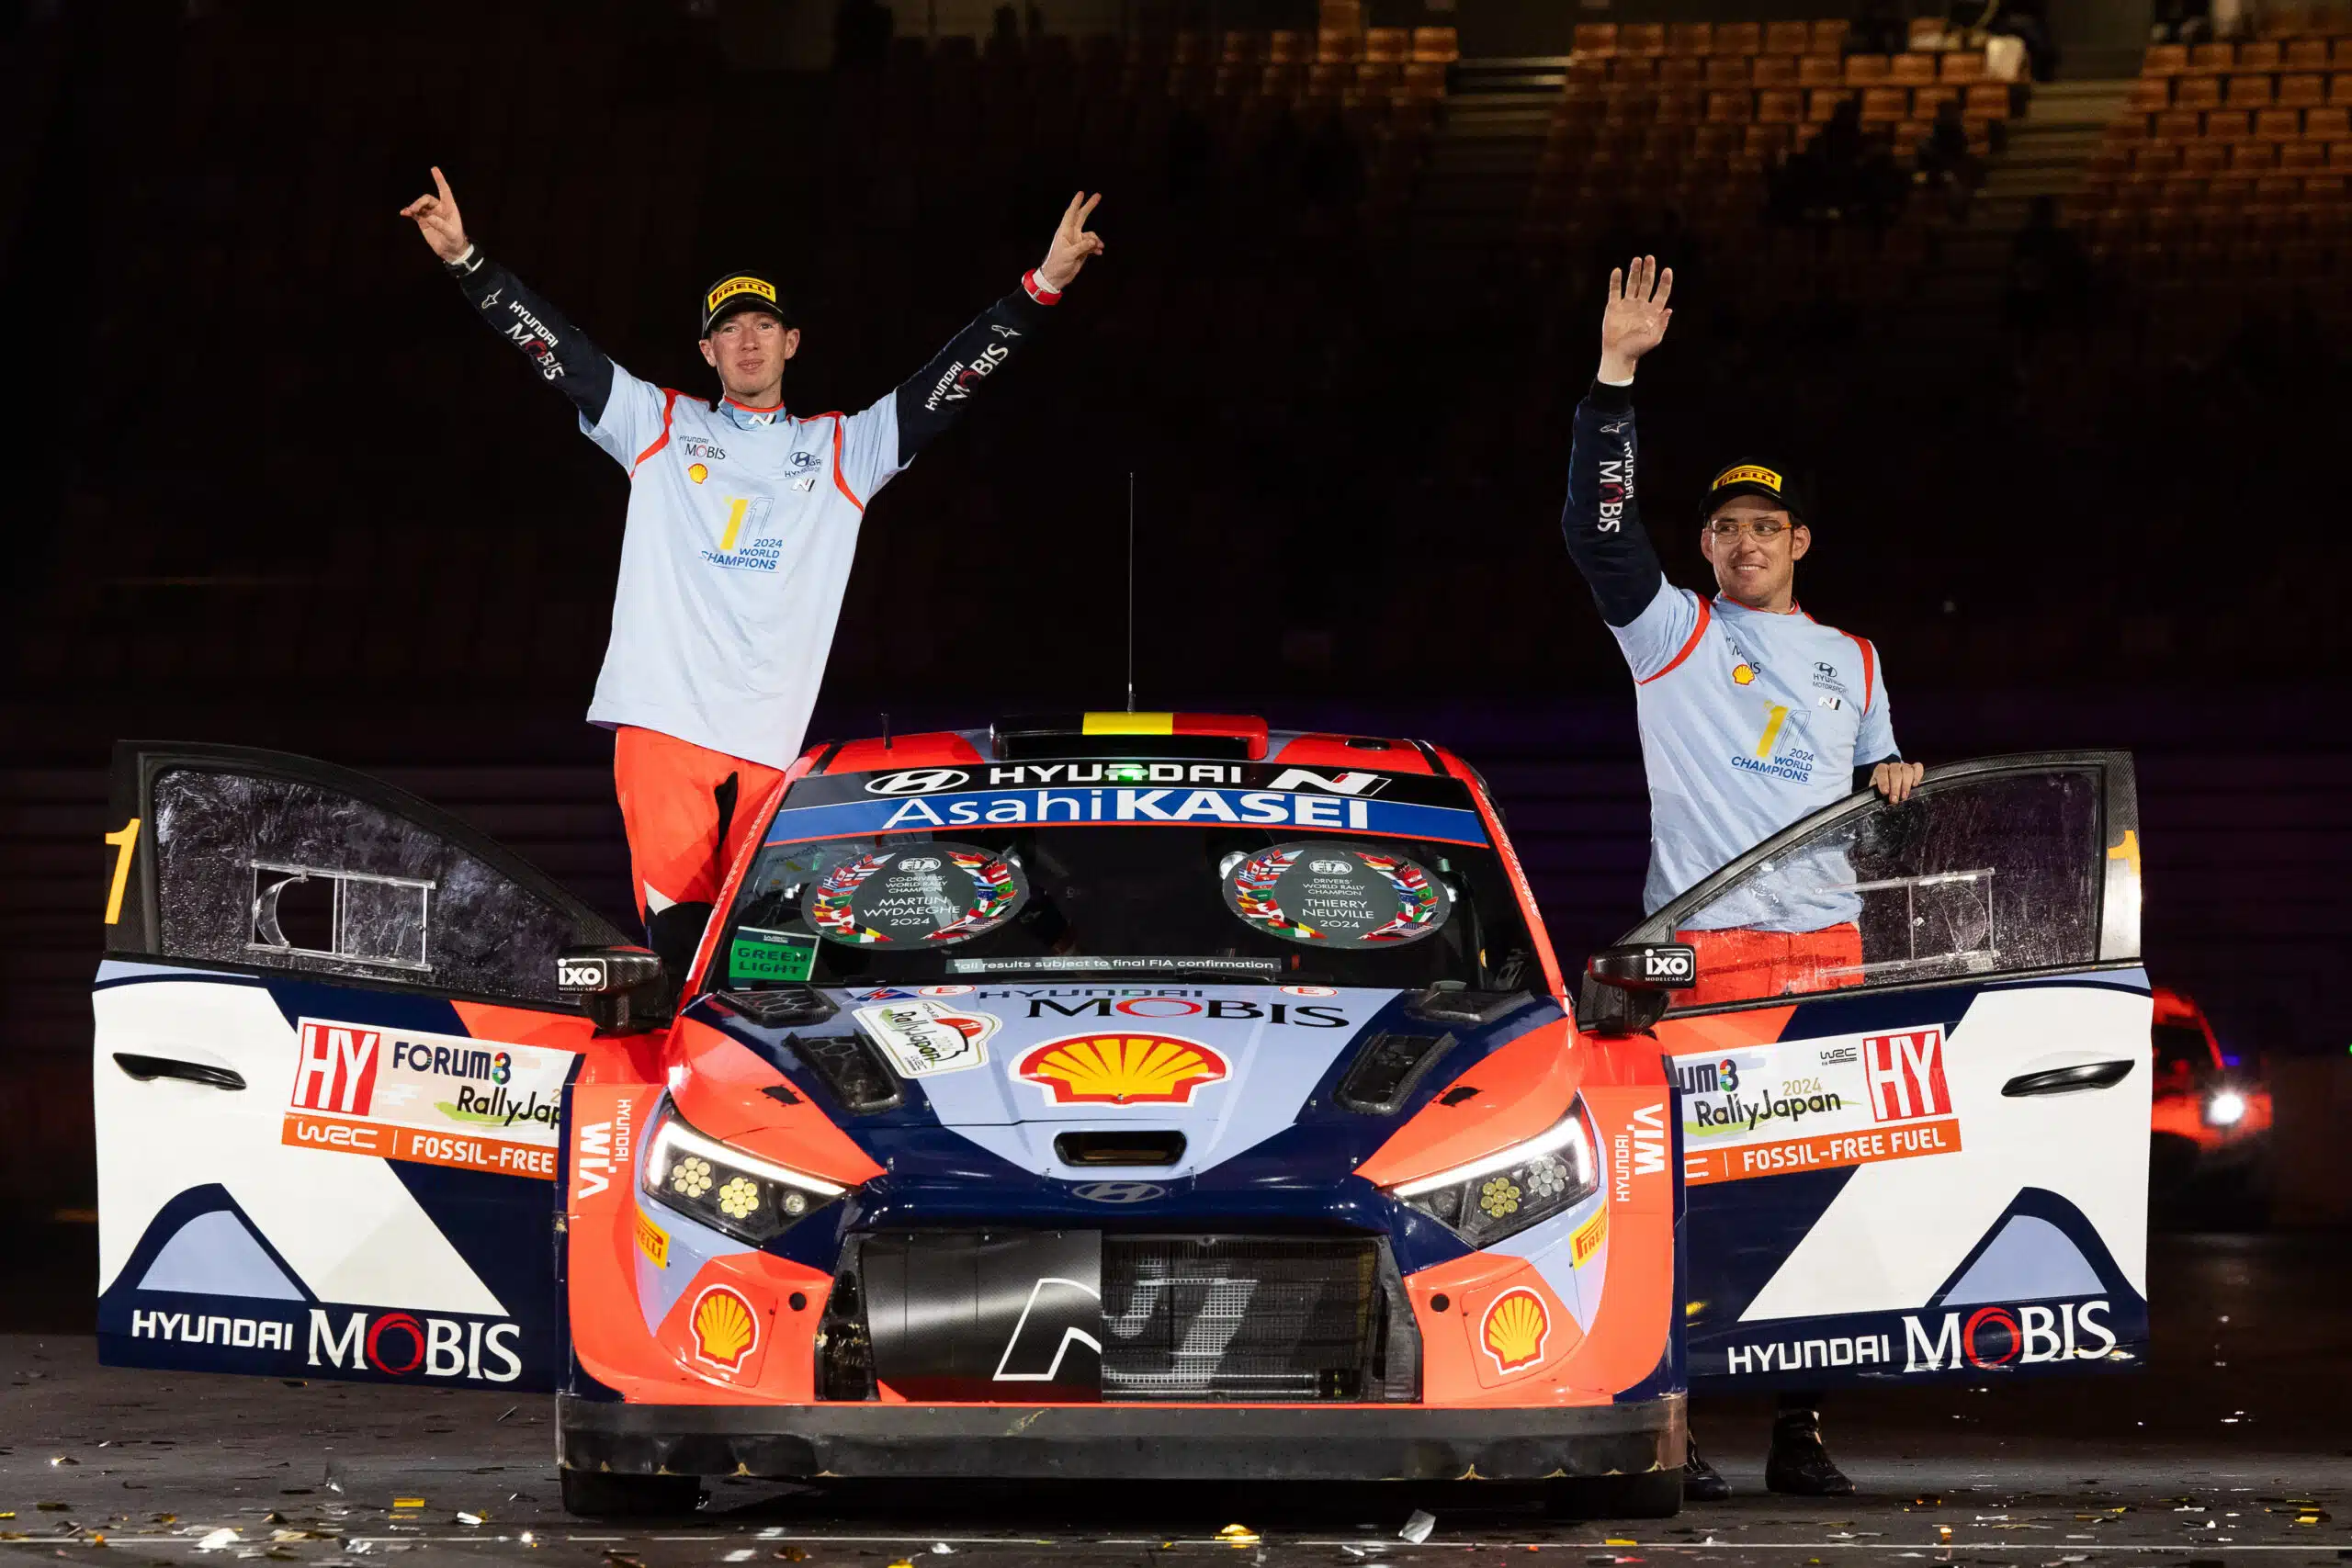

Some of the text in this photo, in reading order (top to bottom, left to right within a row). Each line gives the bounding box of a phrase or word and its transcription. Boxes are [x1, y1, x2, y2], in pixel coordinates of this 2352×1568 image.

[711, 278, 771, 305] PIRELLI
[509, 300, 559, 348] HYUNDAI
[504, 322, 565, 380] MOBIS
[944, 343, 1009, 400] MOBIS
[924, 361, 965, 412] HYUNDAI
[680, 435, 709, 445] HYUNDAI
[684, 444, 726, 460] MOBIS
[1623, 441, 1634, 500] HYUNDAI
[1717, 467, 1775, 487] PIRELLI
[1598, 460, 1624, 533] MOBIS
[739, 548, 780, 558] WORLD
[753, 538, 783, 548] 2024
[1732, 645, 1761, 674] MIS
[1774, 756, 1813, 772] WORLD
[1789, 748, 1815, 762] 2024
[989, 763, 1241, 784] HYUNDAI
[1731, 756, 1809, 783] CHAMPIONS
[105, 817, 141, 924] 1
[899, 859, 940, 872] FIA
[1311, 861, 1351, 873] FIA
[864, 906, 961, 918] WYDAEGHE
[878, 897, 947, 907] MARTIJN
[1305, 898, 1367, 908] THIERRY
[890, 918, 931, 926] 2024
[1302, 908, 1374, 919] NEUVILLE
[1319, 919, 1361, 929] 2024
[738, 948, 808, 962] GREEN
[982, 960, 1031, 970] results
[1035, 959, 1090, 969] subject
[1092, 959, 1110, 967] to
[1113, 959, 1145, 967] final
[1149, 959, 1173, 967] FIA
[1177, 959, 1274, 969] confirmation
[739, 961, 801, 974] LIGHT
[979, 988, 1203, 999] HYUNDAI
[1024, 997, 1351, 1028] MOBIS
[1819, 1046, 1857, 1060] WRC
[293, 1025, 378, 1113] HY
[1866, 1032, 1937, 1121] HY
[1781, 1077, 1823, 1097] 2024
[297, 1121, 378, 1149] WRC
[615, 1099, 631, 1162] HYUNDAI
[412, 1135, 555, 1174] FOSSIL-FREE
[1743, 1127, 1947, 1172] FOSSIL-FREE FUEL
[1614, 1134, 1631, 1202] HYUNDAI
[131, 1308, 522, 1382] HYUNDAI MOBIS
[1727, 1300, 2117, 1374] HYUNDAI MOBIS
